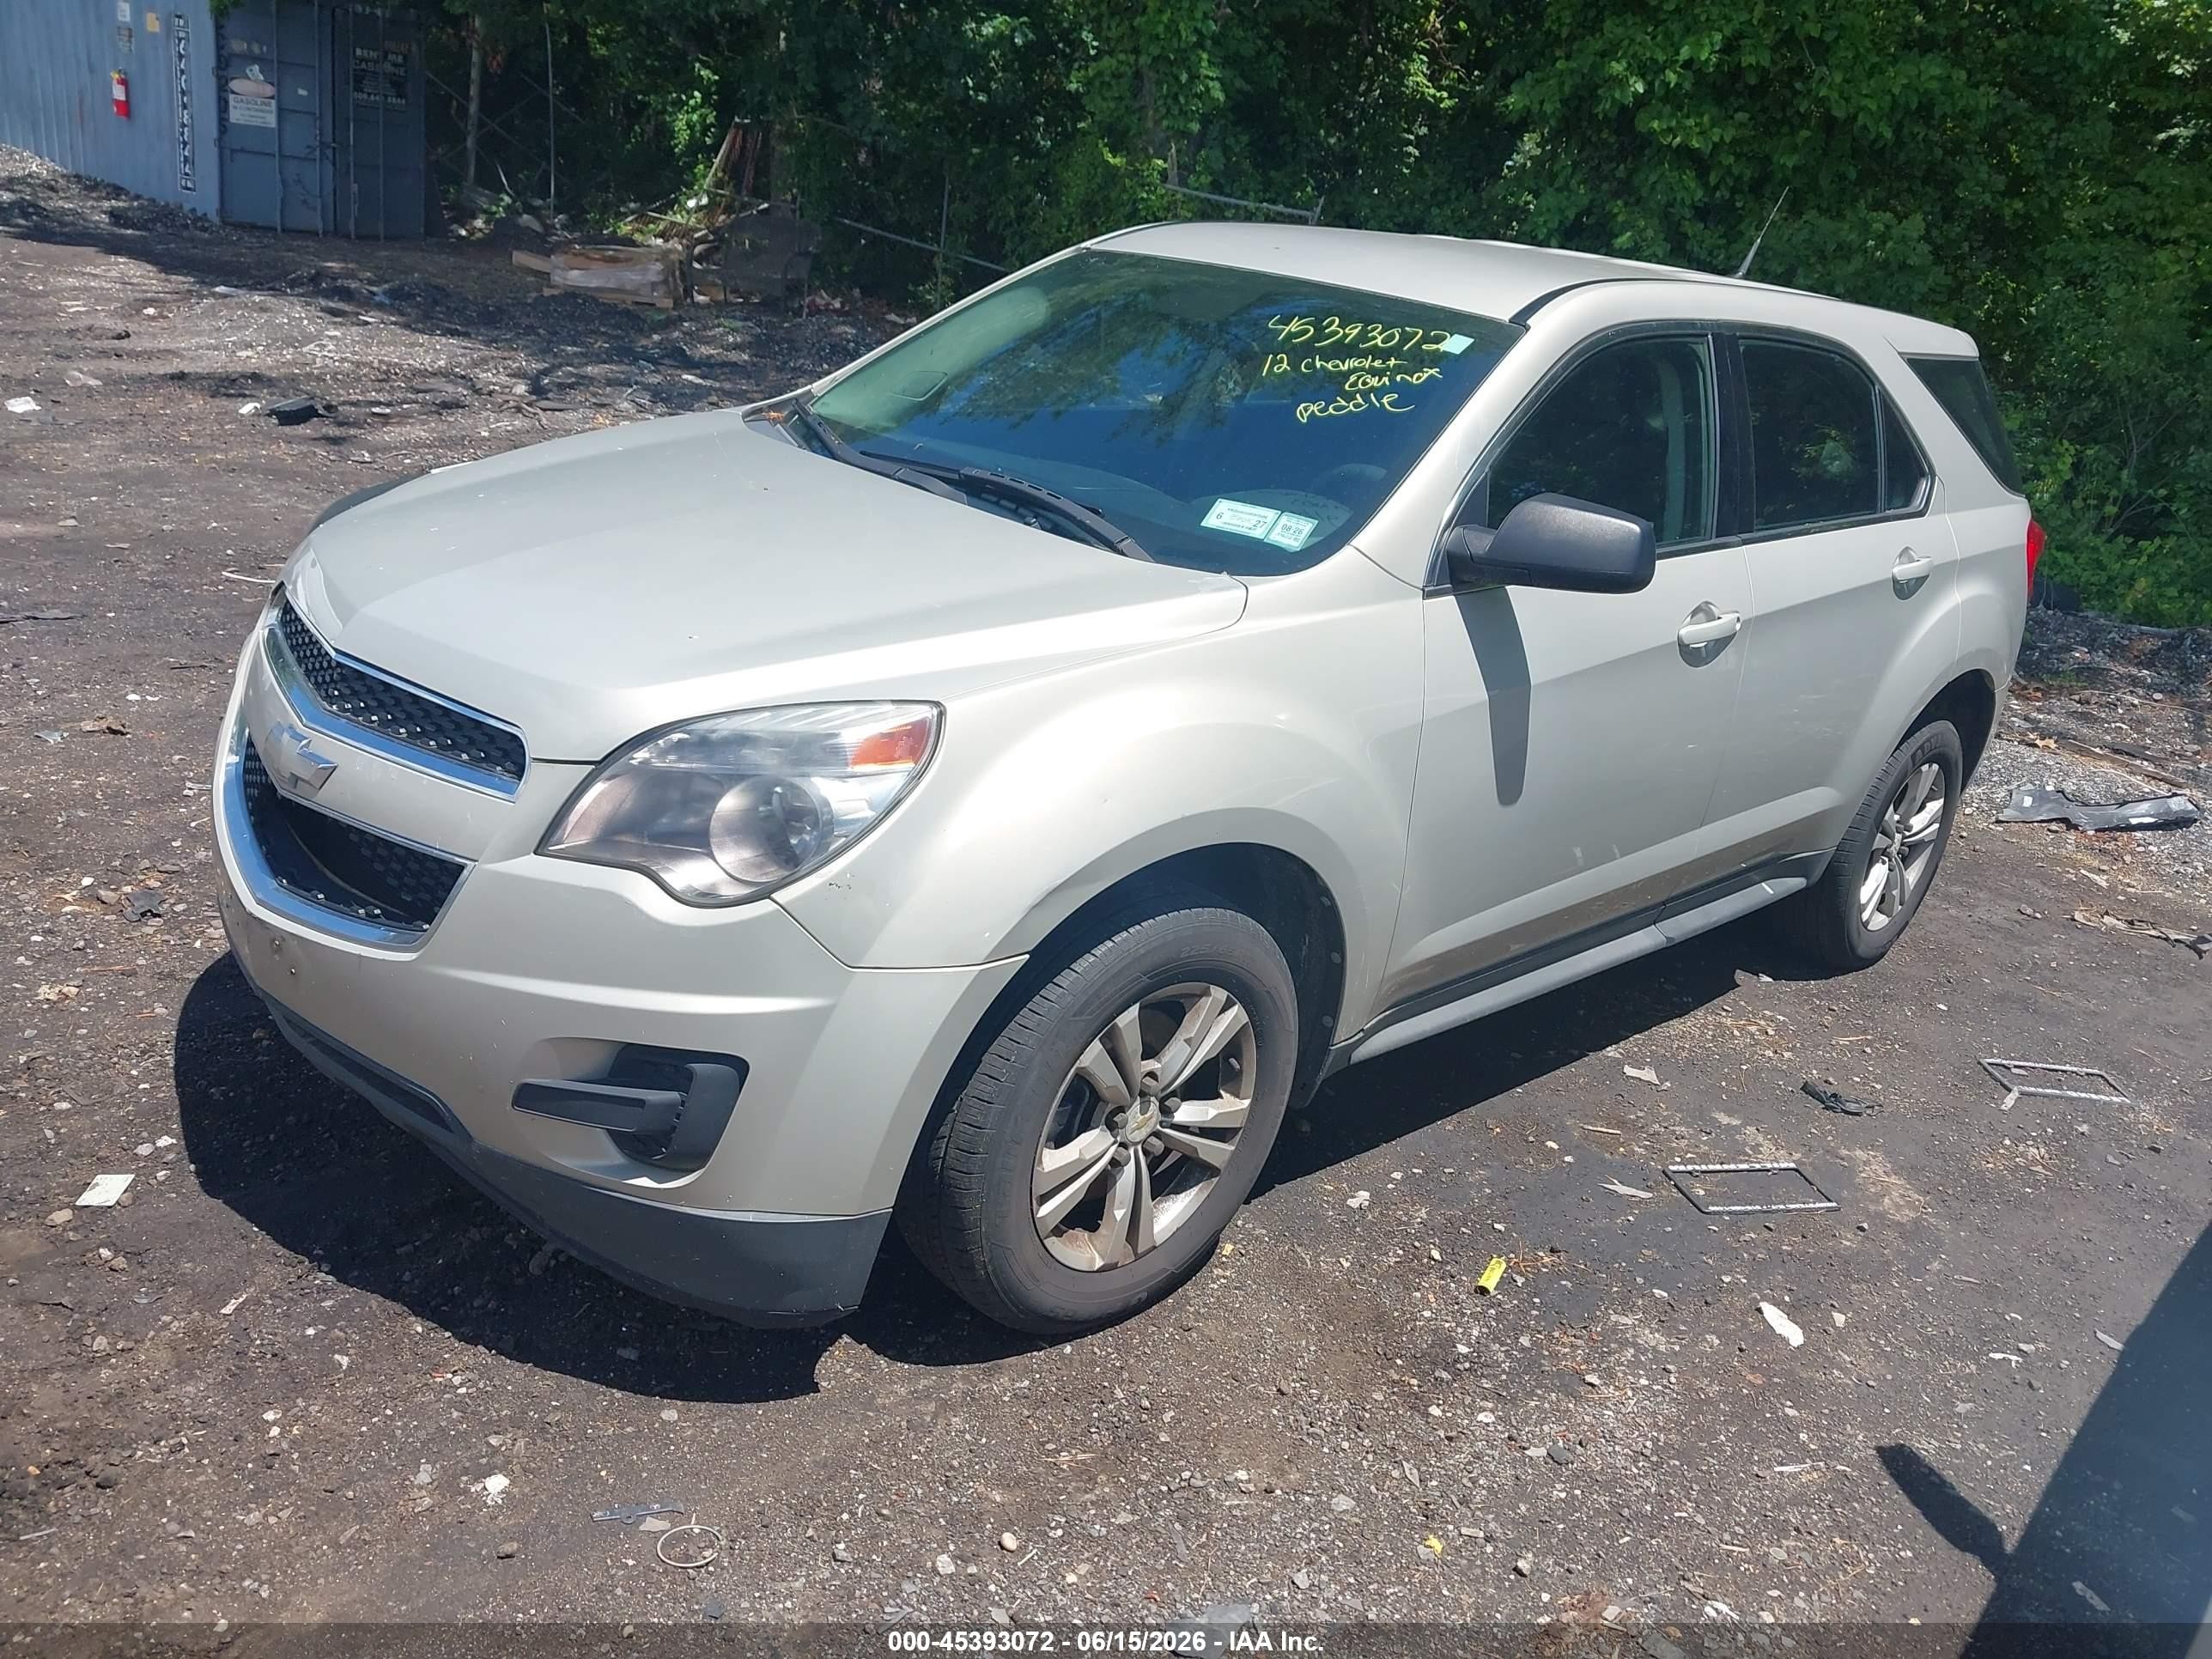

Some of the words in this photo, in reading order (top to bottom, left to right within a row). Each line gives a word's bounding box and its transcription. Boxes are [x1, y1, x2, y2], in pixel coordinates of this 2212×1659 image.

[233, 96, 272, 108] GASOLINE
[1267, 314, 1450, 351] 45393072
[1262, 354, 1291, 376] 12
[1253, 520, 1267, 529] 27
